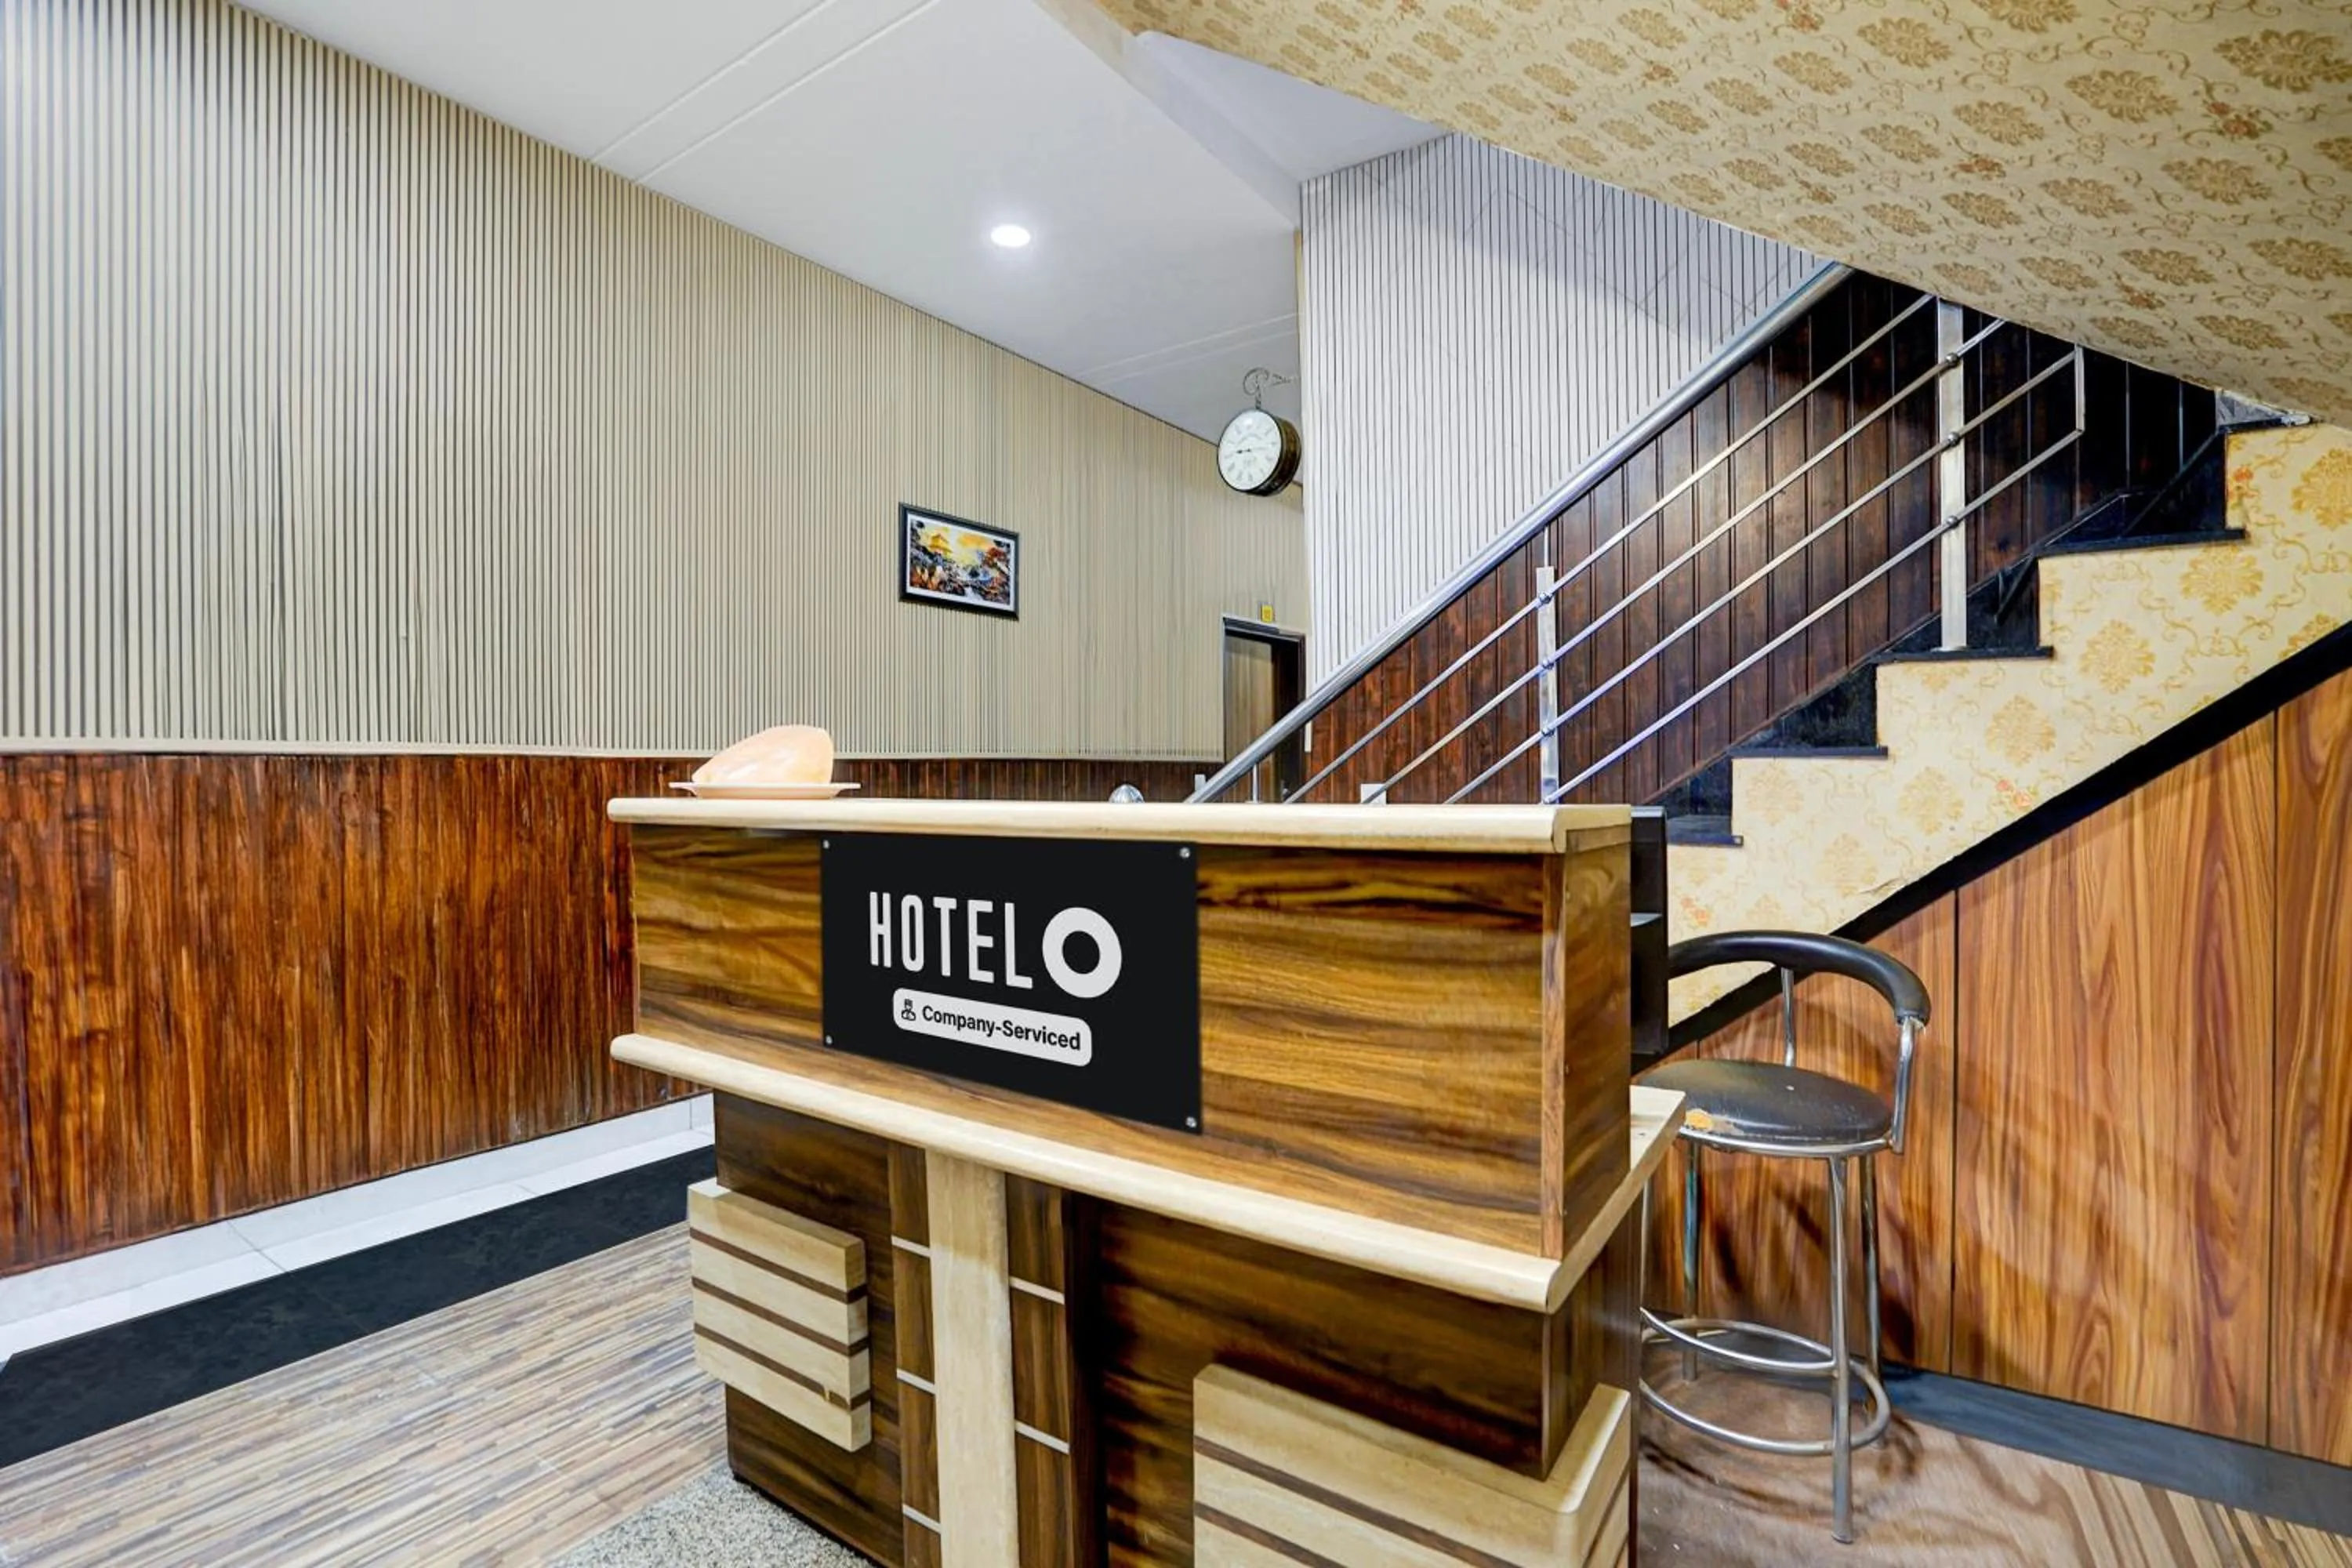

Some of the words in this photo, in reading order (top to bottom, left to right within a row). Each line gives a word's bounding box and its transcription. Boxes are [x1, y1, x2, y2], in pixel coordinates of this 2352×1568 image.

[869, 891, 1033, 989] HOTEL
[1042, 907, 1122, 998] O
[922, 1005, 1080, 1051] Company-Serviced
